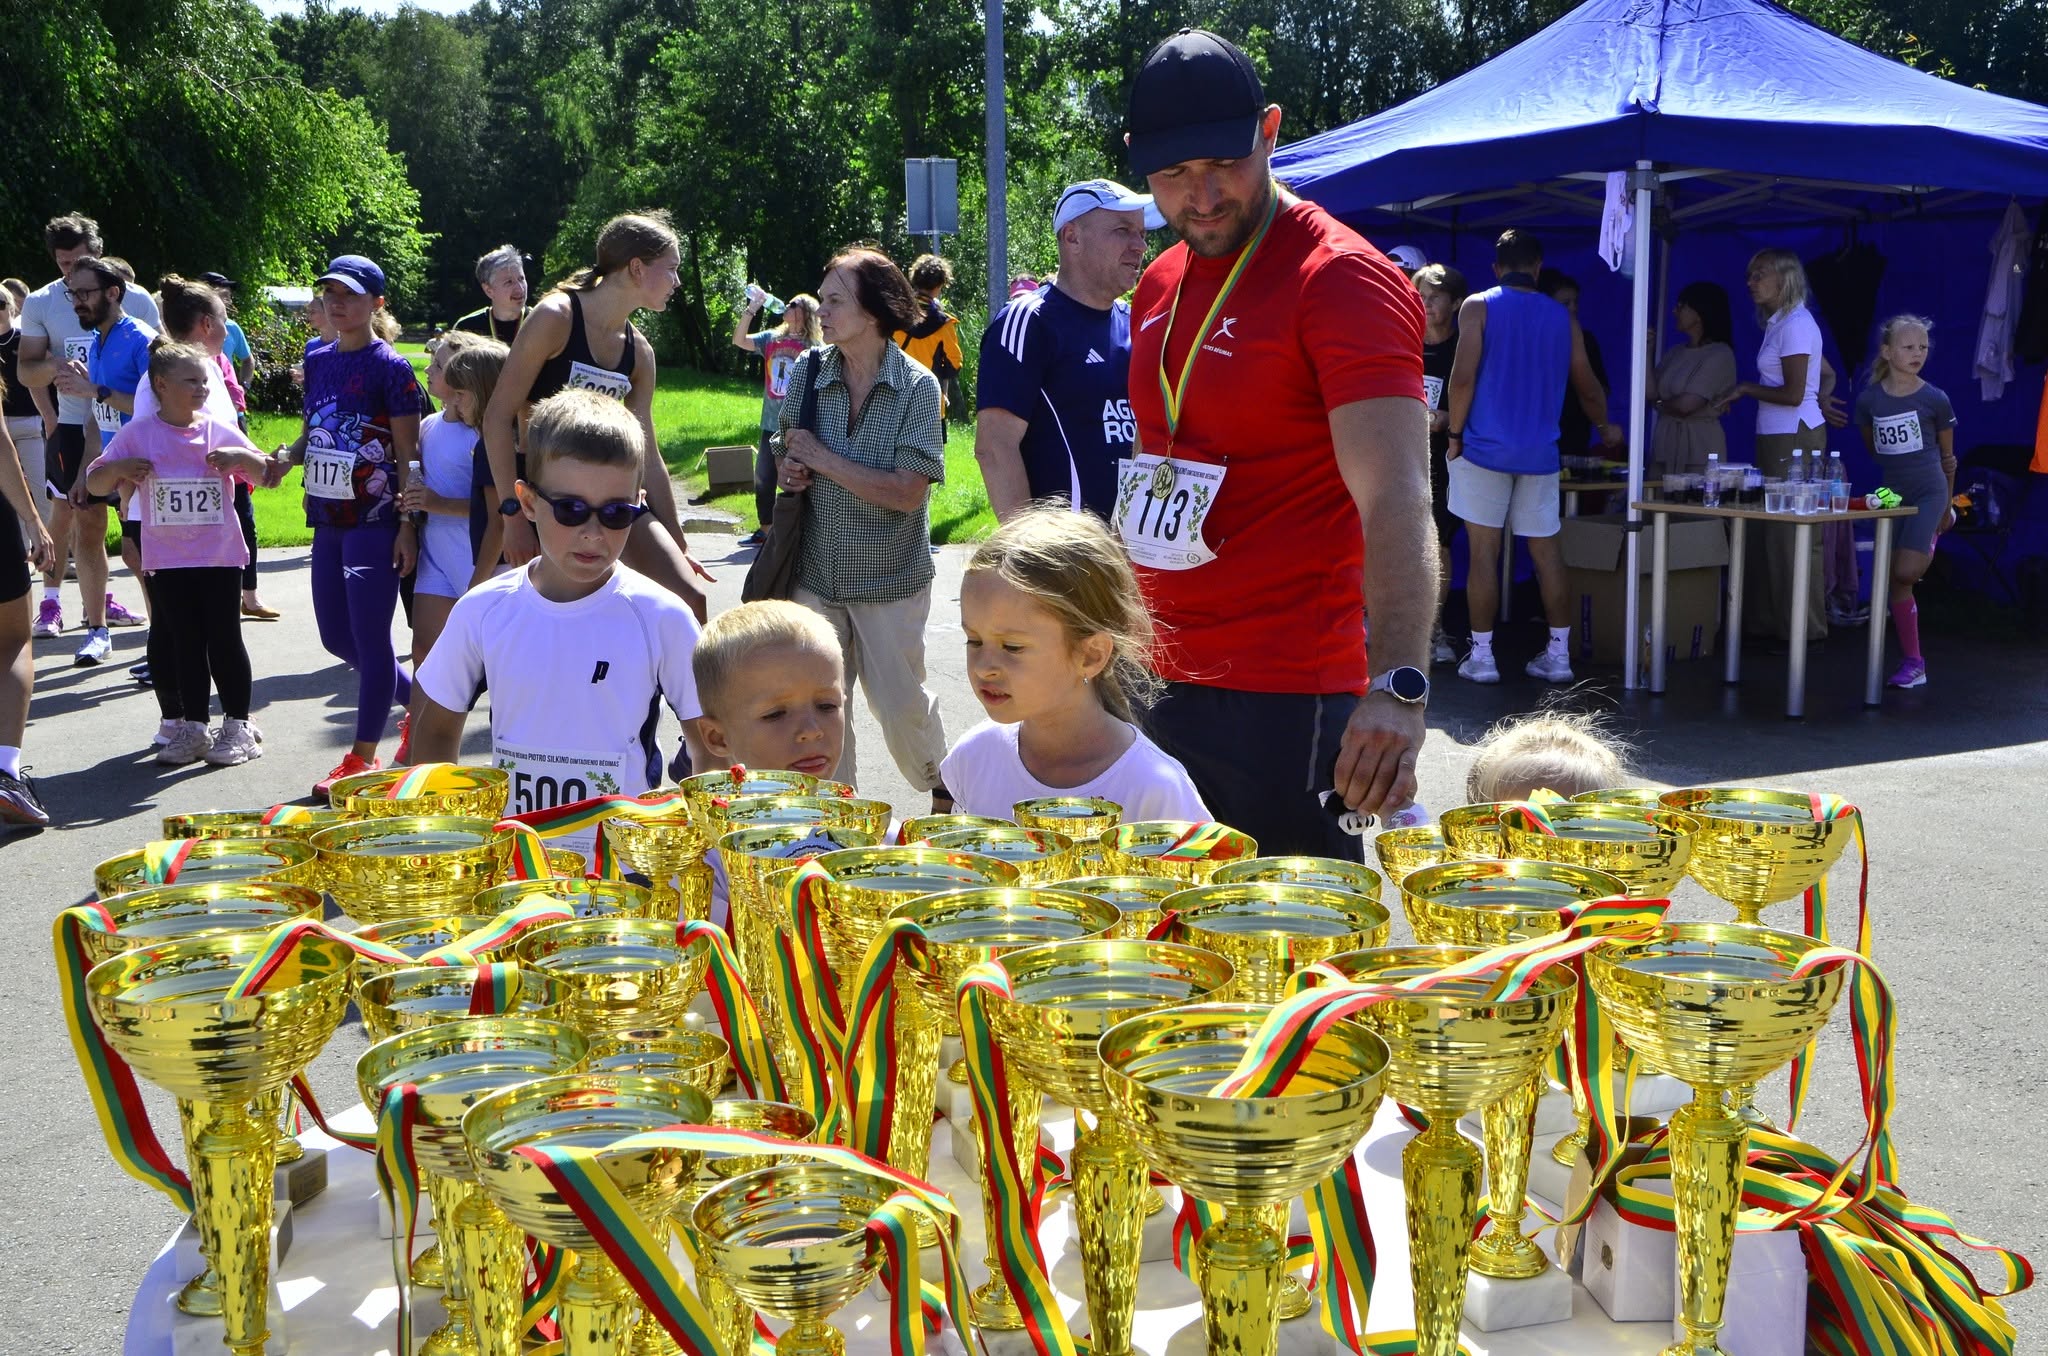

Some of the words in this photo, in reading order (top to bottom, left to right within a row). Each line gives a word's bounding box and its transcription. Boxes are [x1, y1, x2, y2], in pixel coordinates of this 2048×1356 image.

[1878, 424, 1909, 445] 535
[314, 460, 338, 486] 117
[170, 489, 208, 513] 512
[1138, 489, 1190, 541] 113
[528, 752, 547, 762] PIOTRO
[547, 755, 570, 764] SILKINO
[569, 757, 599, 766] GIMTADIENIO
[598, 759, 620, 767] BĖGIMAS
